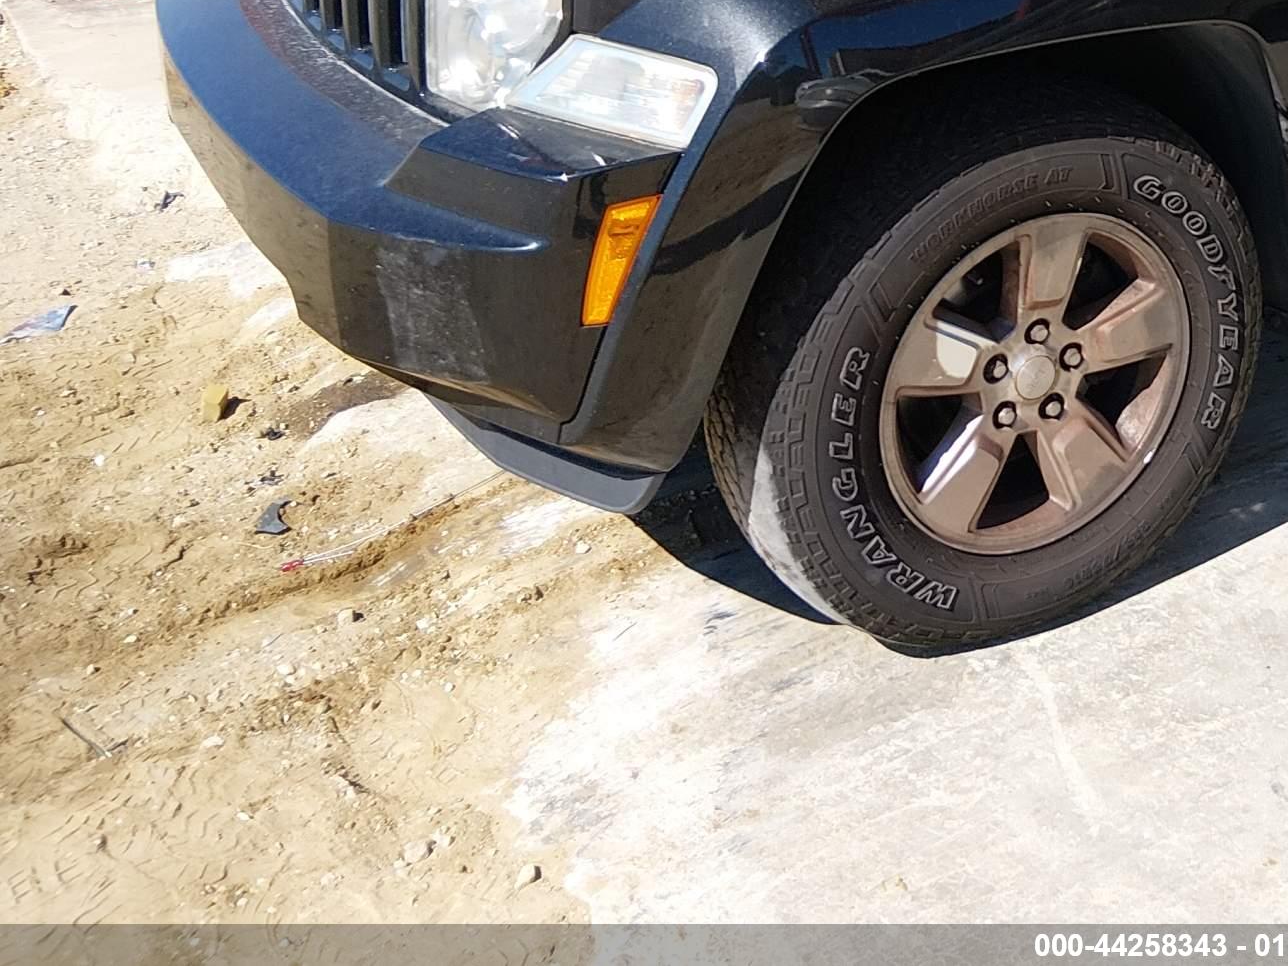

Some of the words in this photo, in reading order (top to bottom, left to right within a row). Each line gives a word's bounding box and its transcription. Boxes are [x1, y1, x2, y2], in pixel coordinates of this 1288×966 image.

[908, 173, 1039, 264] WORKHORSE
[1043, 166, 1073, 184] AT
[1132, 173, 1240, 430] GOODYEAR
[828, 346, 960, 611] WRANGLER
